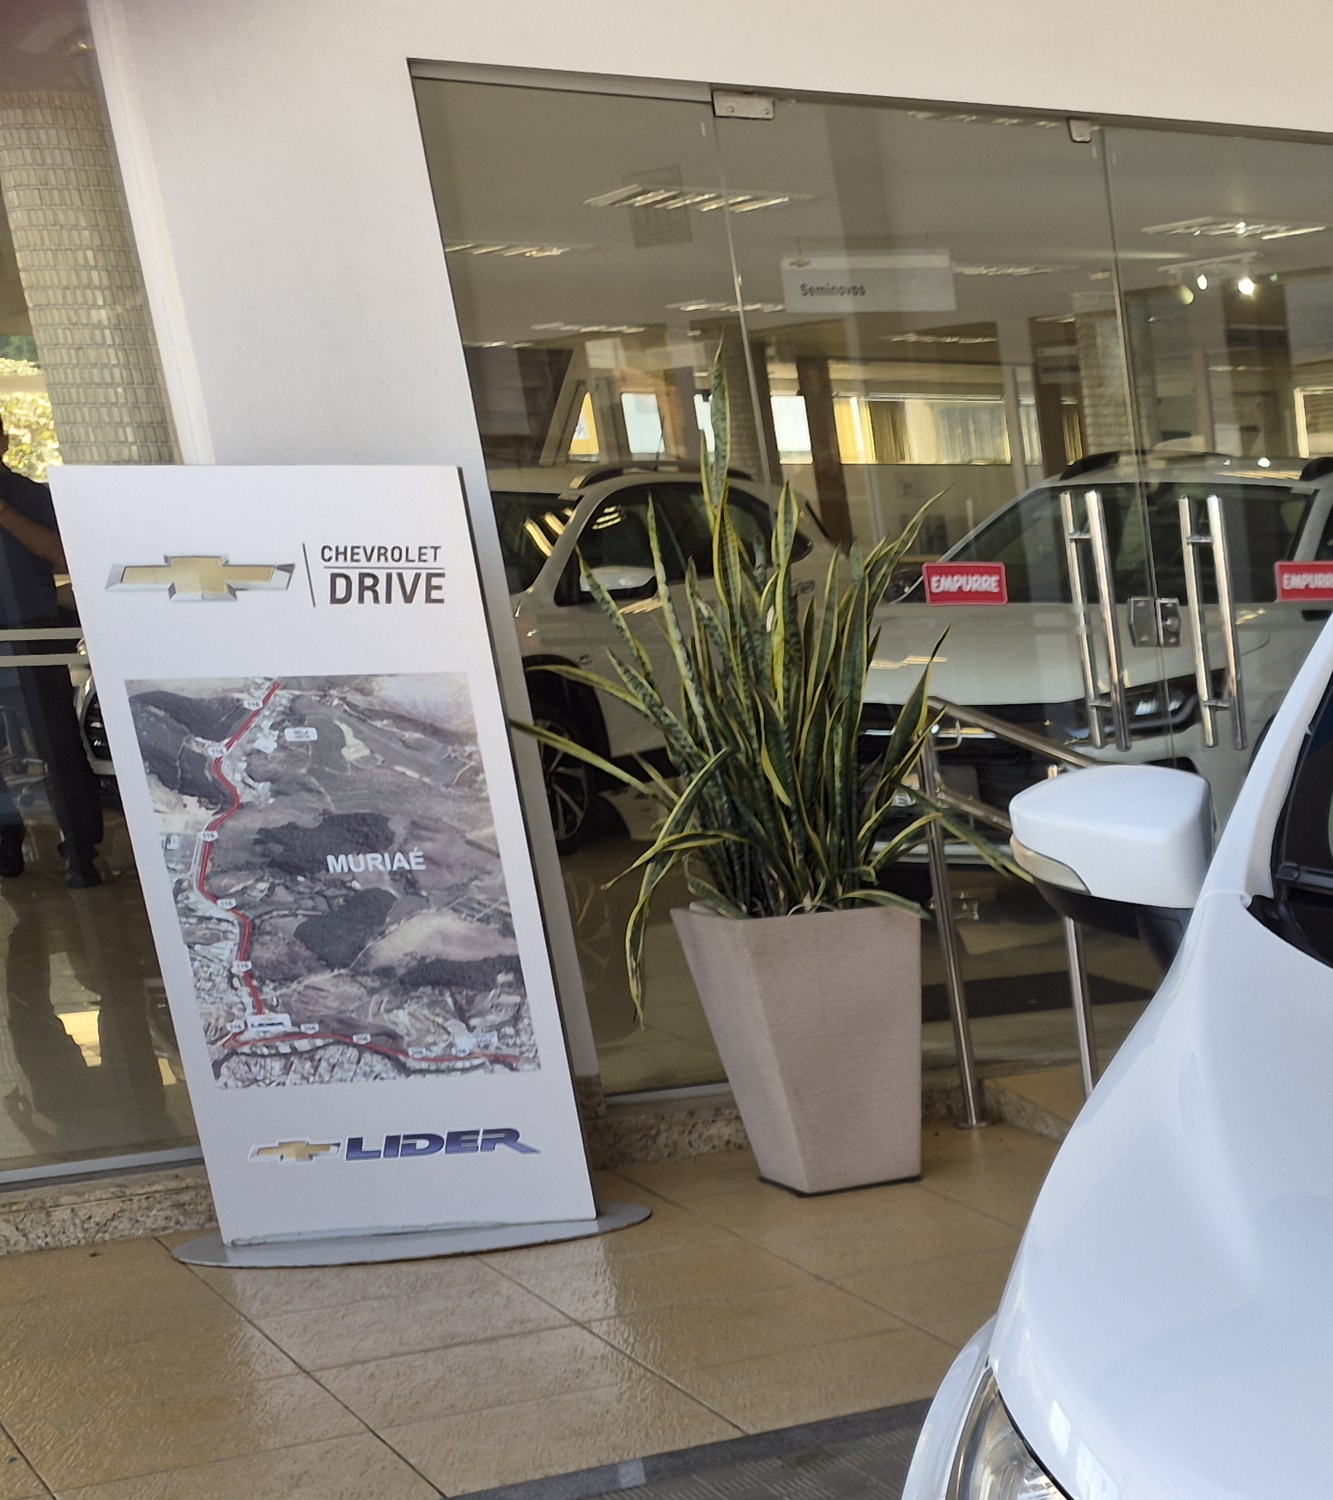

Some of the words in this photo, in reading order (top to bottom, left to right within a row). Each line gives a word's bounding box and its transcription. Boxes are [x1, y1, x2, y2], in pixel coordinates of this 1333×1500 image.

[800, 282, 866, 297] Seminovos
[320, 545, 442, 563] CHEVROLET
[329, 572, 446, 605] DRIVE
[930, 574, 1000, 593] EMPURRE
[326, 846, 427, 874] MURIAÉ
[345, 1128, 542, 1161] LIDER
